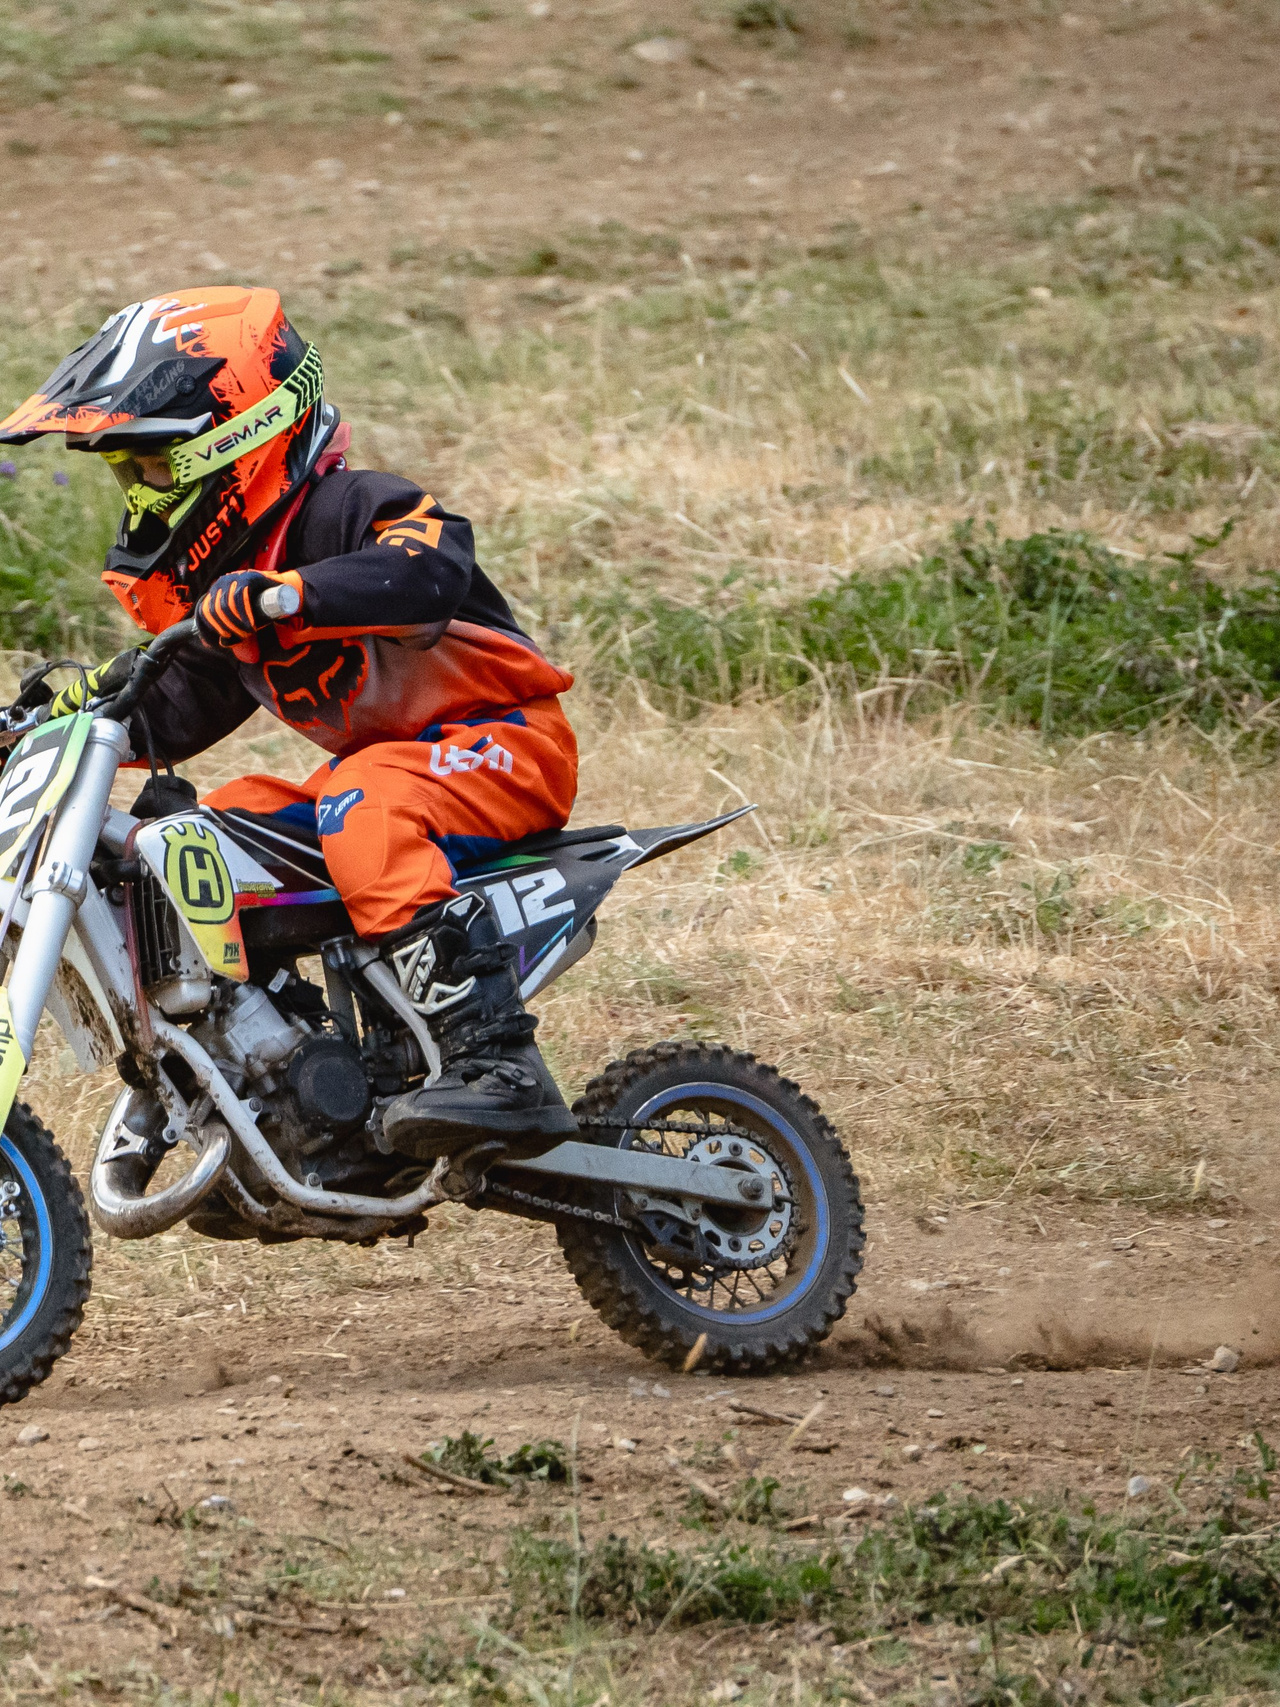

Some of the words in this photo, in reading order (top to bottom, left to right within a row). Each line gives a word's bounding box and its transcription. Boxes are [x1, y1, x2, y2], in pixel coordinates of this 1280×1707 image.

[194, 405, 284, 461] VEMAR
[187, 495, 241, 572] JUST1
[334, 789, 360, 817] LEATT
[483, 867, 577, 937] 12
